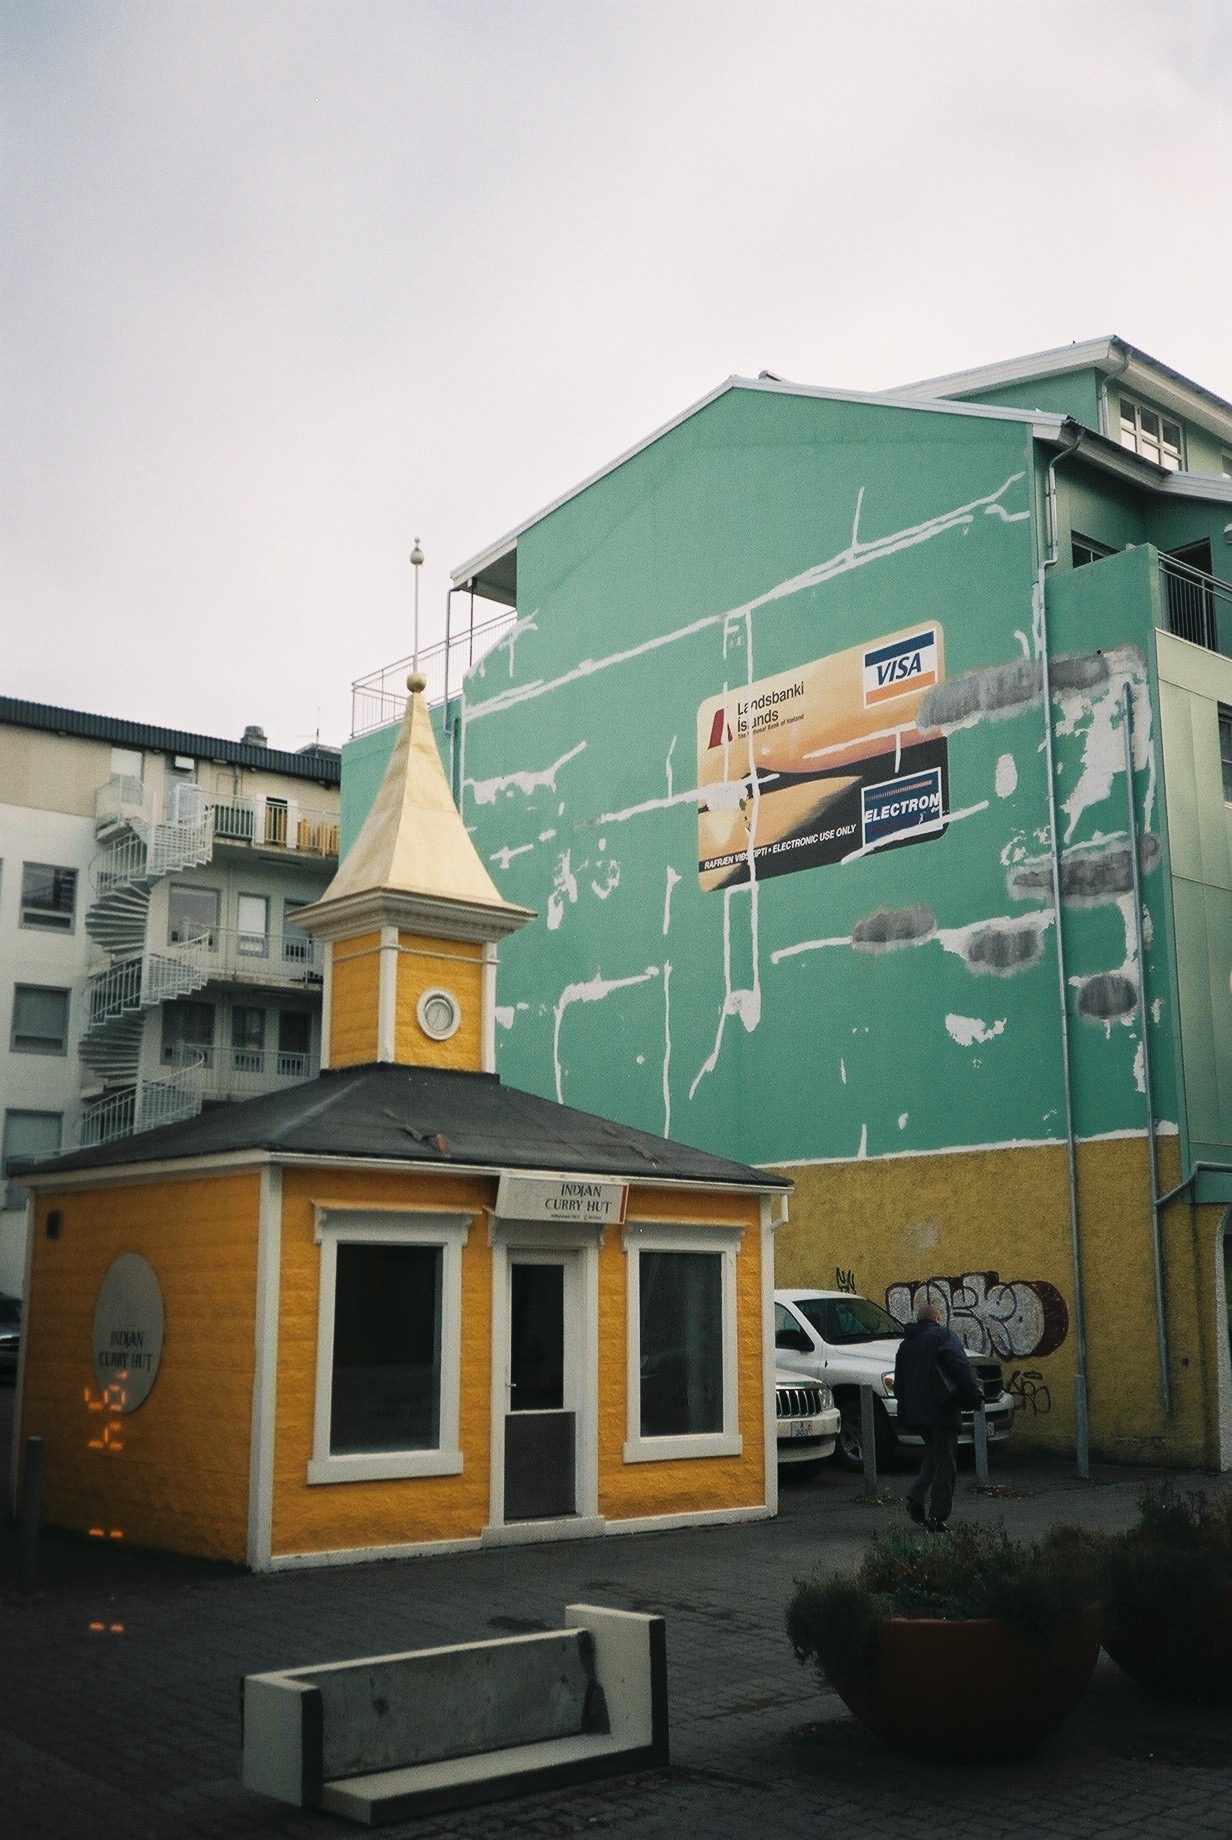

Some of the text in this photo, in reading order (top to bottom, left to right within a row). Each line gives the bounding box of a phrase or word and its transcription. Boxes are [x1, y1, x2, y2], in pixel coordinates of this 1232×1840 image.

[877, 653, 922, 685] VISA
[737, 709, 779, 733] Ísands
[864, 792, 940, 824] ELECTRON
[772, 834, 820, 854] ELECTRONIC
[819, 829, 836, 842] USE
[835, 823, 857, 837] ONLY
[561, 1183, 602, 1198] INDIAN
[544, 1198, 613, 1214] CURRY HUT
[110, 1330, 145, 1348] INDIAN
[98, 1351, 154, 1372] CURRY HUT
